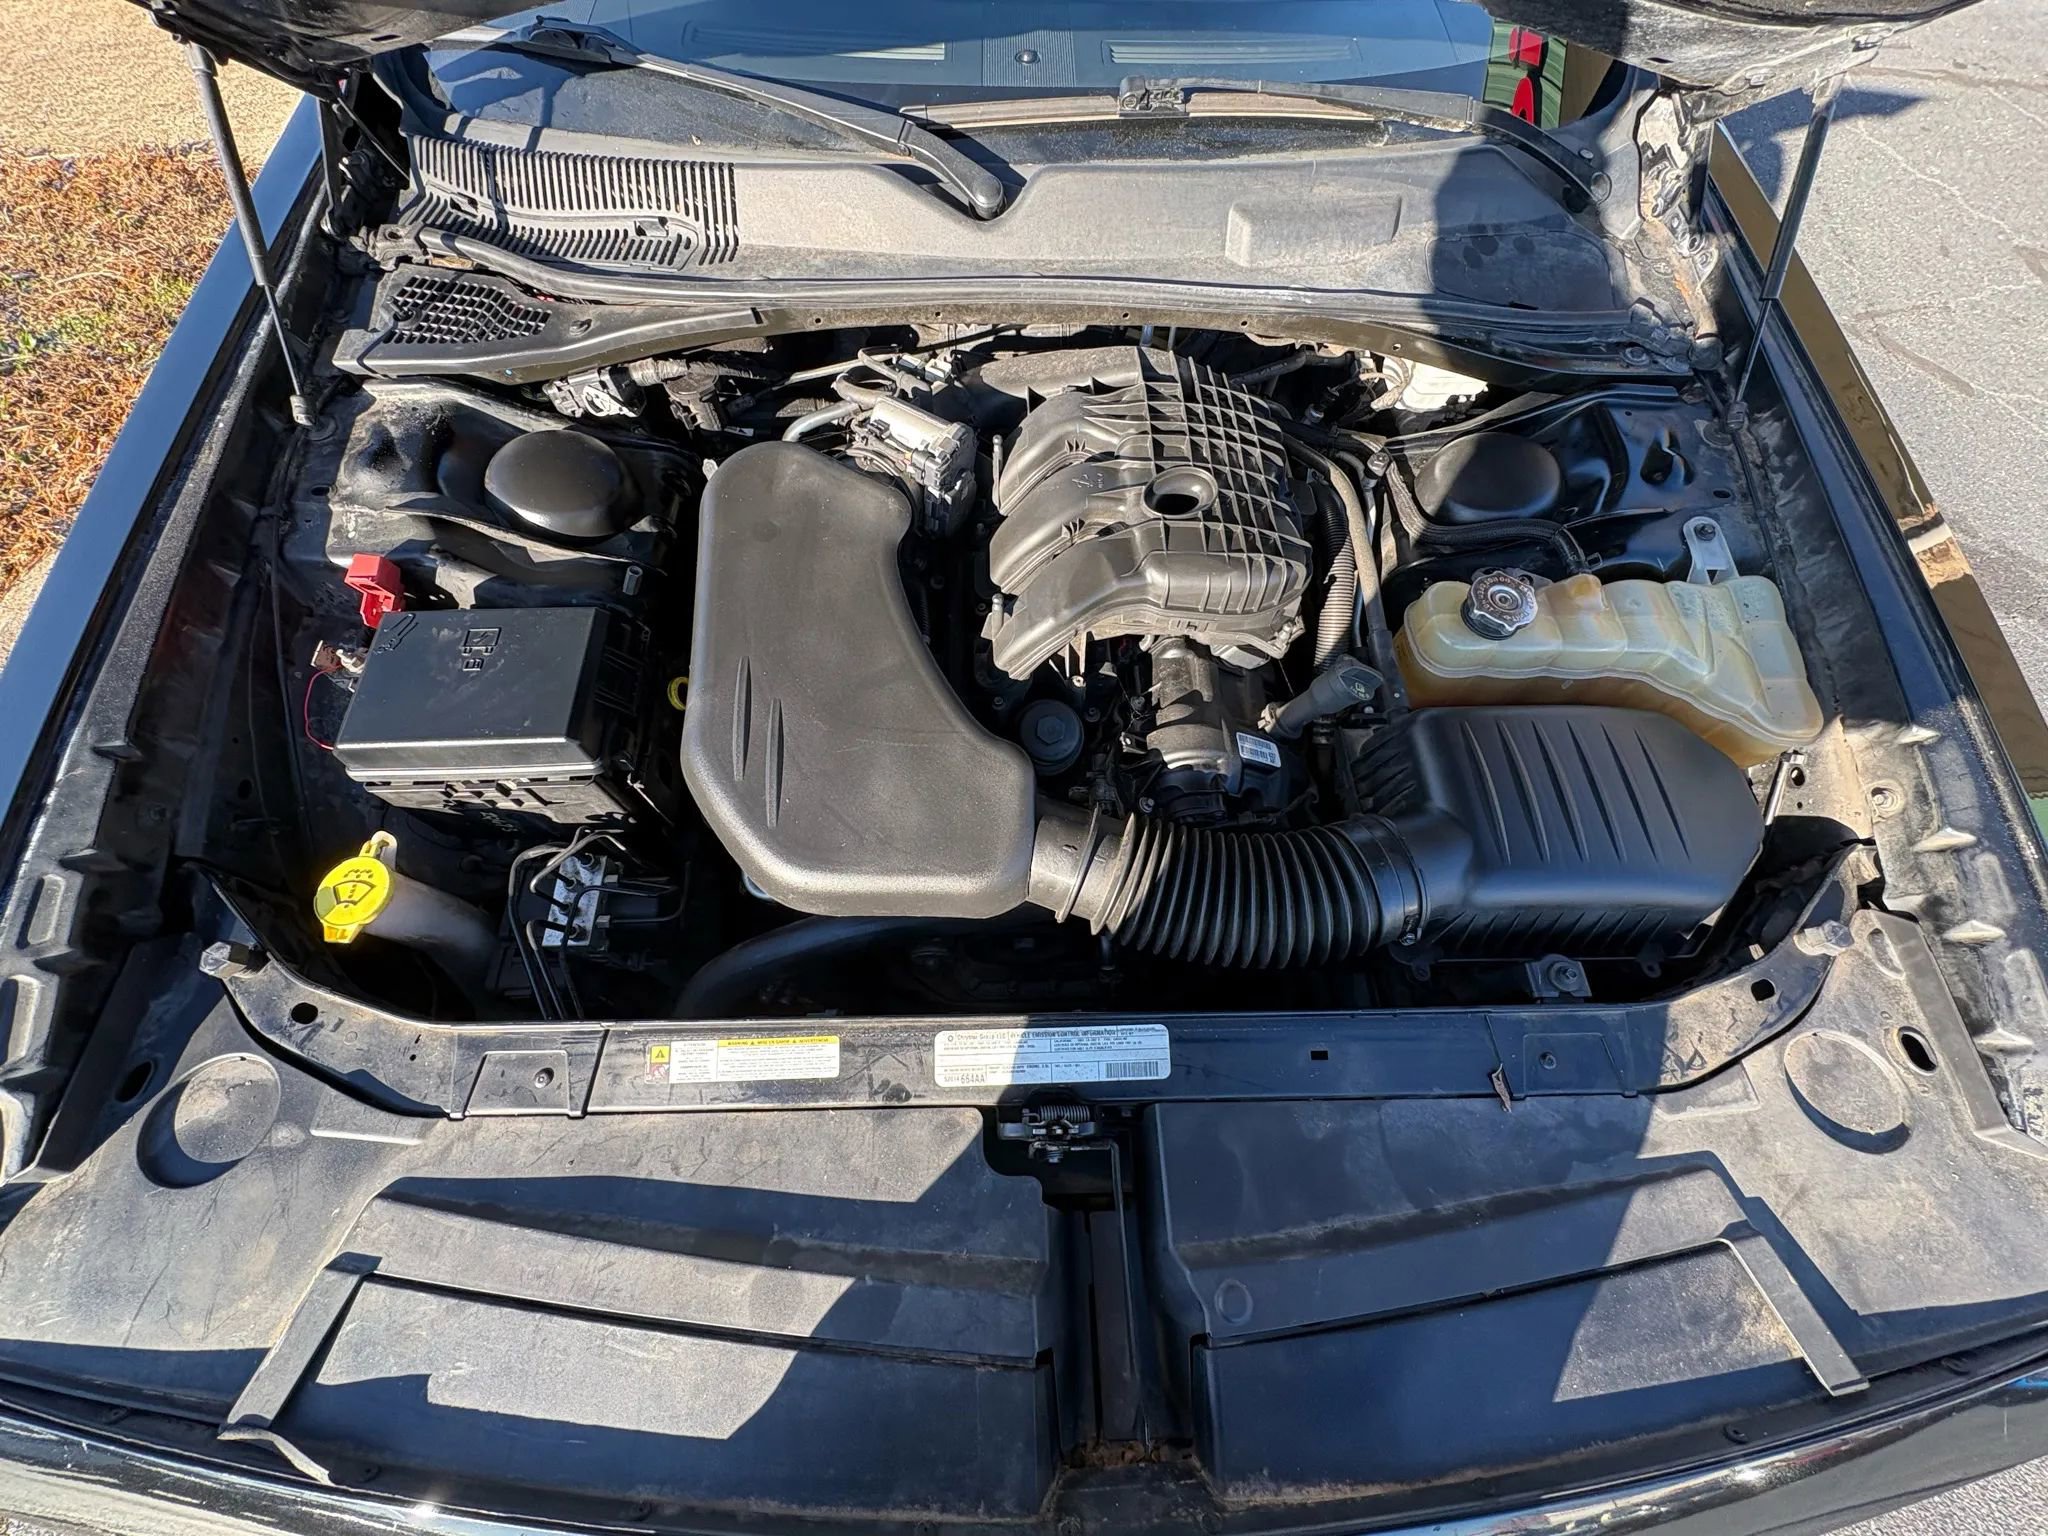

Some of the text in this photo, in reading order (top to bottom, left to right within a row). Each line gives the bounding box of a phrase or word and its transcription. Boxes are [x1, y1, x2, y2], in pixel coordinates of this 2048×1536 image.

[1032, 1030, 1055, 1038] EMISSION
[1057, 1029, 1080, 1038] CONTROL
[1081, 1027, 1116, 1037] INFORMATION
